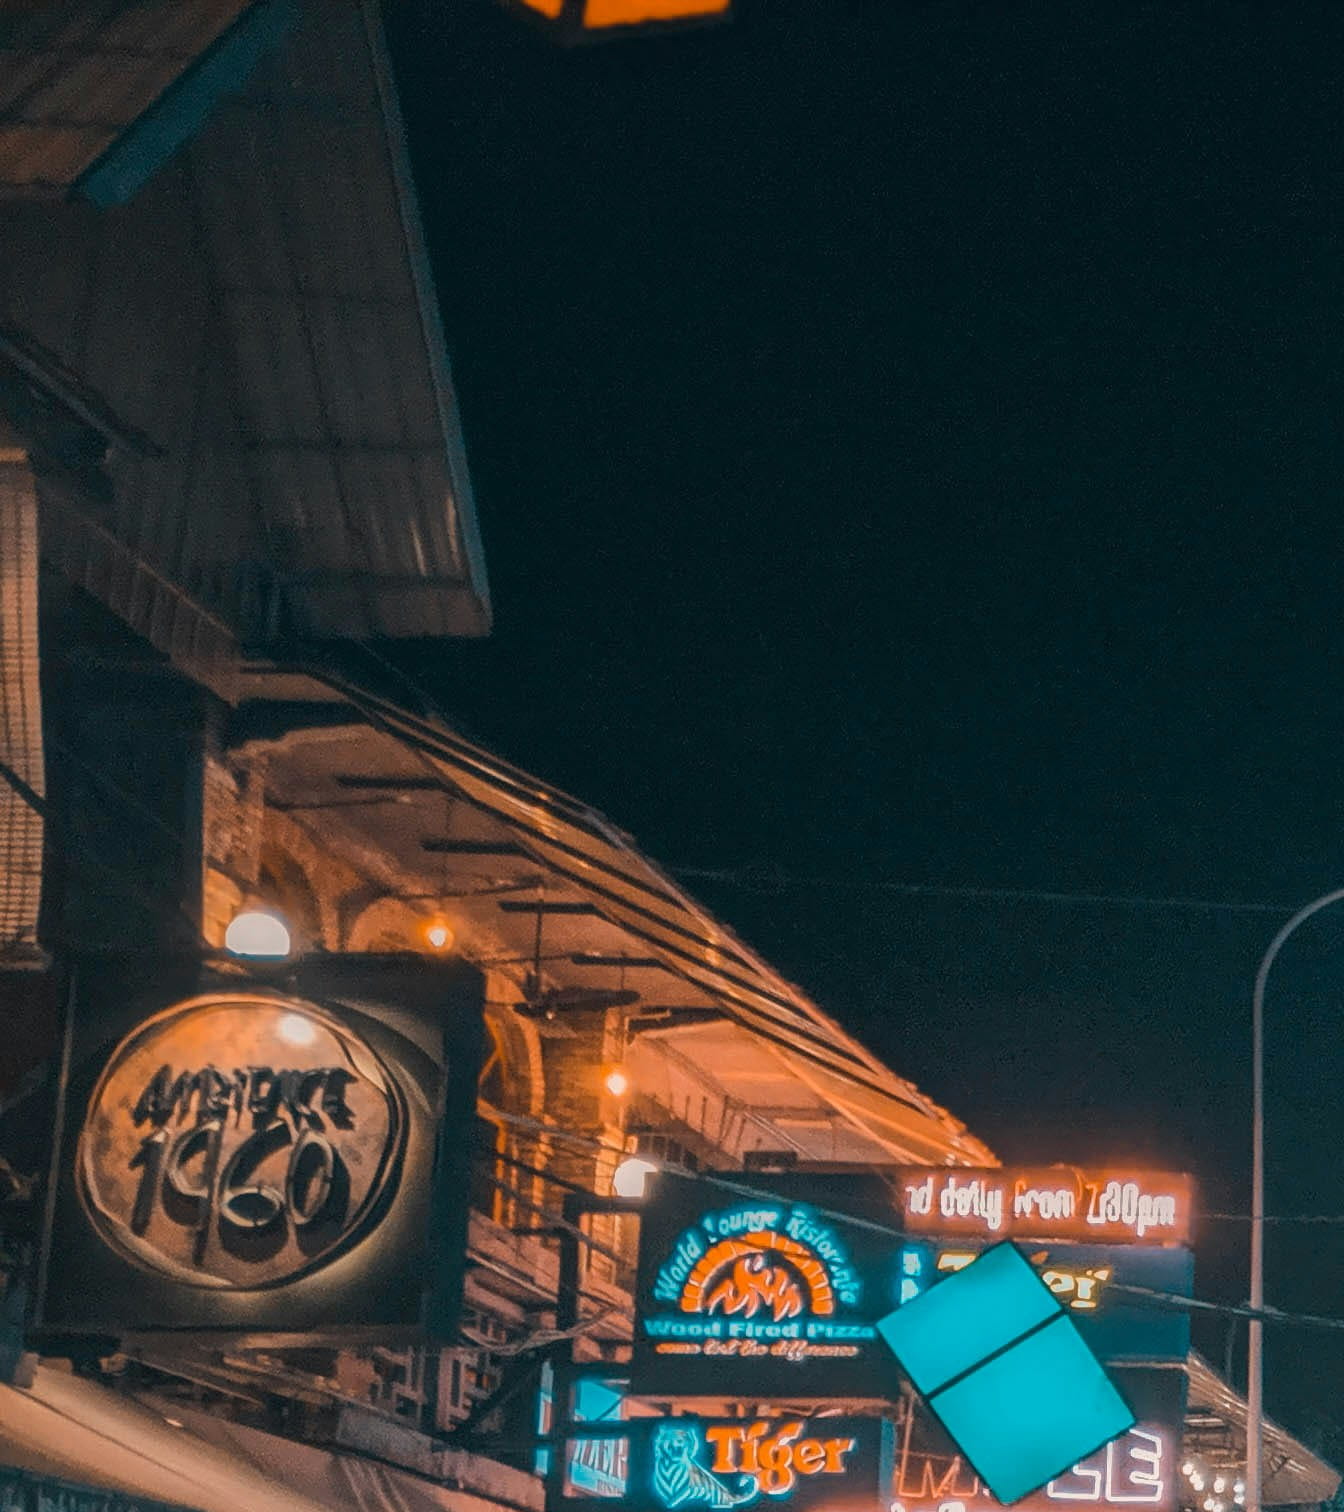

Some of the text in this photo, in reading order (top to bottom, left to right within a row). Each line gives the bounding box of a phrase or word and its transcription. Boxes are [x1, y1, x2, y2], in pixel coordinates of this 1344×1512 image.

[128, 1118, 351, 1266] 1960
[655, 1230, 701, 1302] World
[644, 1319, 876, 1339] Wood Fired Pizza
[705, 1420, 857, 1494] Tiger
